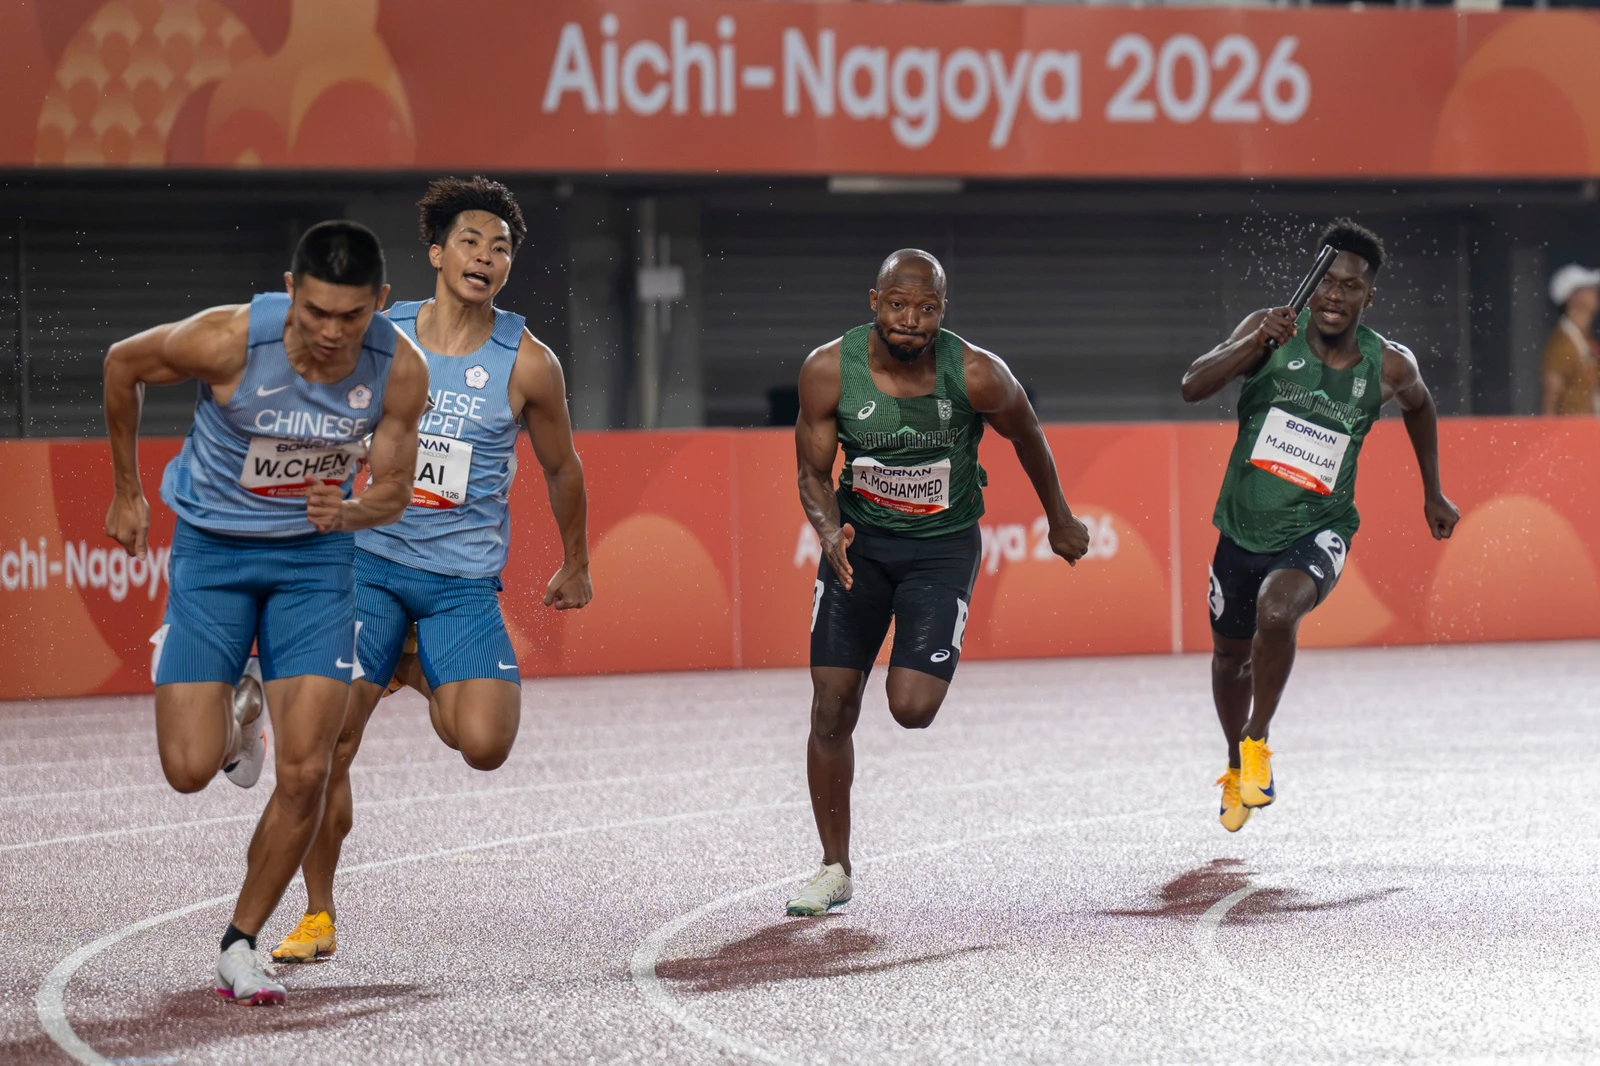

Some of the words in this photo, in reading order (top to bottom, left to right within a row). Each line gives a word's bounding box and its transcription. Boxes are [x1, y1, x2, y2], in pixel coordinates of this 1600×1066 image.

[542, 13, 1081, 148] Aichi-Nagoya
[1105, 33, 1311, 124] 2026
[1277, 378, 1313, 412] SAUDI
[1313, 395, 1363, 426] ARABIA
[255, 409, 369, 438] CHINESE
[1286, 420, 1337, 444] BORNAN
[857, 431, 900, 449] SAUDI
[904, 427, 958, 449] ARABIA
[1267, 435, 1337, 470] M.ABDULLAH
[254, 453, 350, 479] W.CHEN
[872, 464, 932, 478] BORNAN
[440, 489, 460, 500] 1126
[861, 471, 942, 498] A.MOHAMMED
[928, 494, 943, 504] 821
[0, 536, 173, 603] chi-Nagoy
